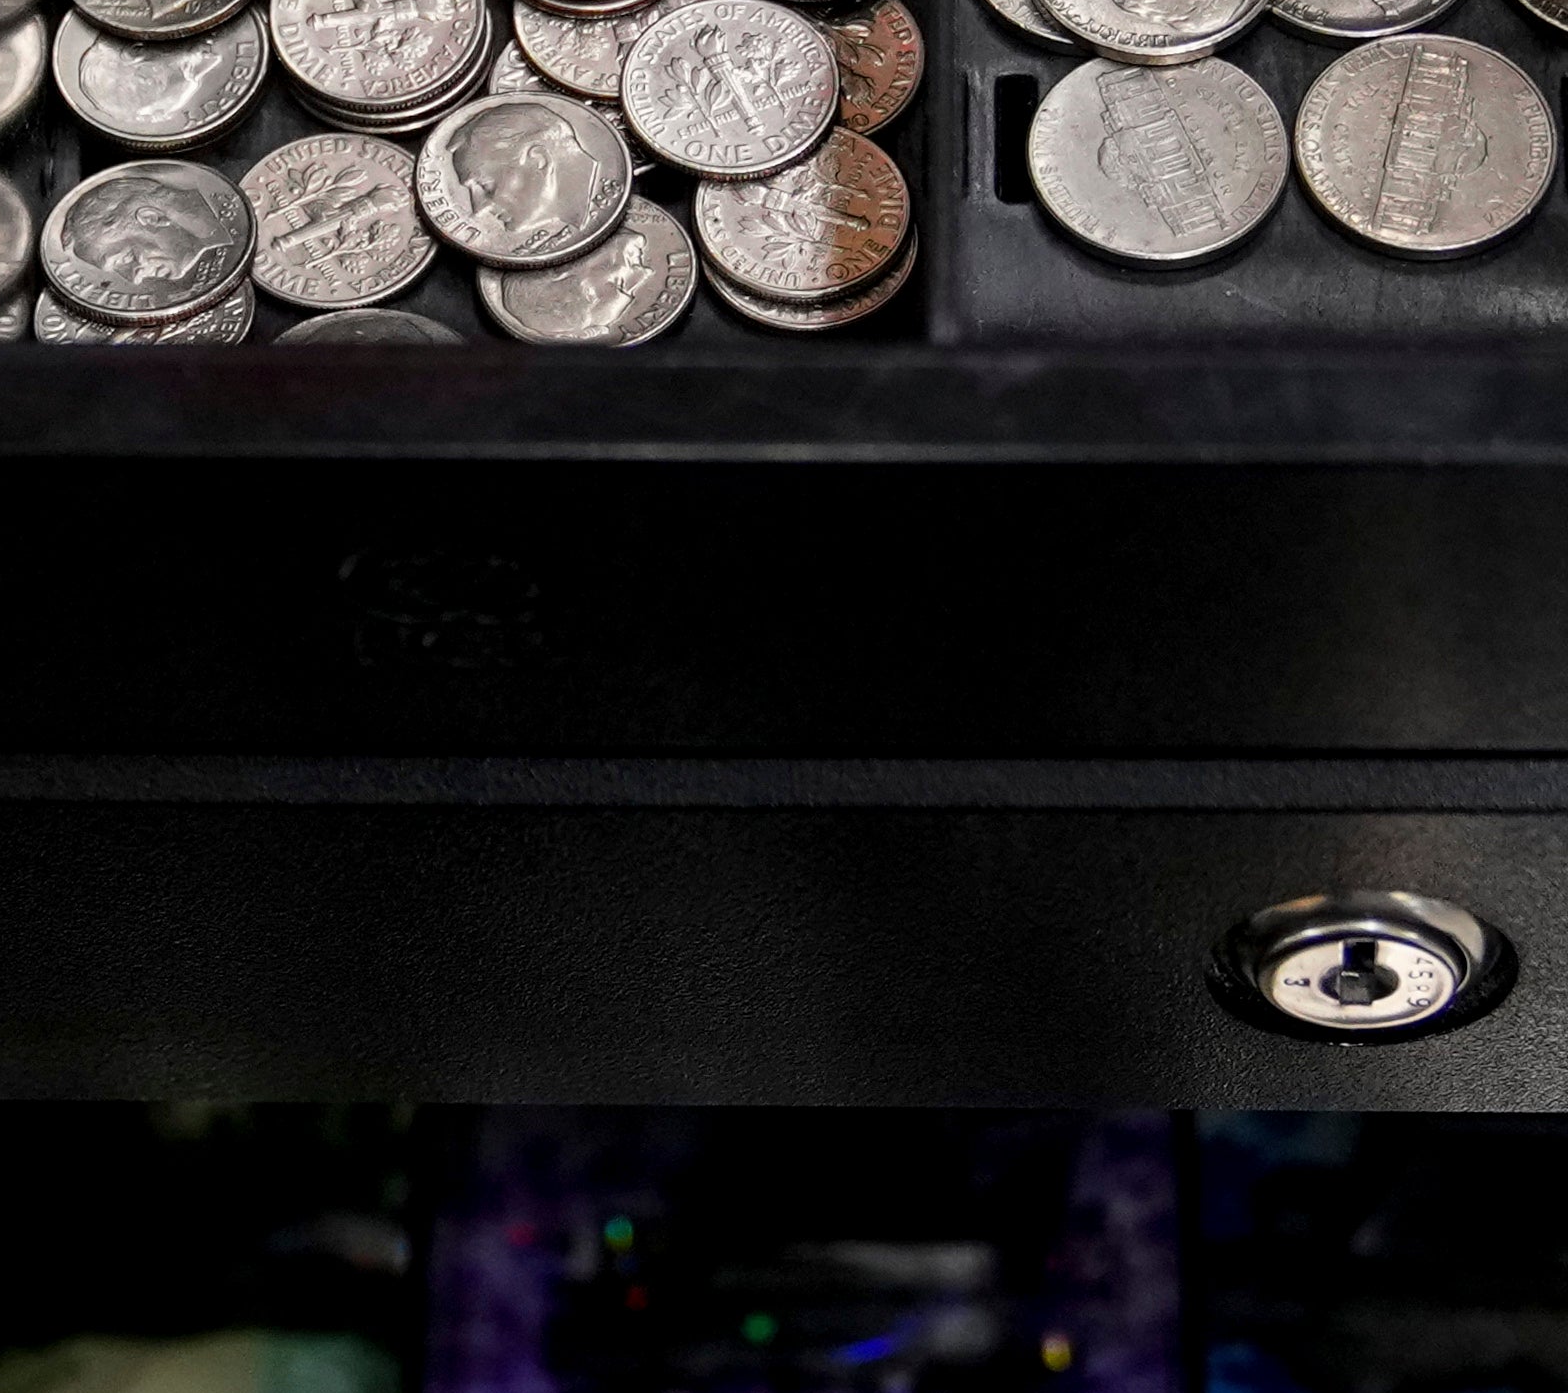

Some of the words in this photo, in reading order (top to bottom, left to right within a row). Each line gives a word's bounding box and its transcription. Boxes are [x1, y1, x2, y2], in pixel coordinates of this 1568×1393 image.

[278, 22, 339, 88] DIME
[452, 17, 476, 47] OF
[522, 23, 590, 82] AMERICA
[1086, 16, 1171, 49] LIBERTY
[181, 40, 256, 132] LIBERTY
[359, 43, 462, 97] AMERICA
[629, 69, 666, 139] UNITED
[648, 7, 706, 65] STATES
[715, 2, 747, 23] OF
[752, 7, 830, 79] AMERICA
[265, 136, 353, 173] UNITED
[682, 138, 754, 166] ONE
[763, 95, 828, 159] DIME
[418, 149, 481, 246] LIBERTY
[825, 237, 892, 282] ONE
[869, 162, 907, 232] DIME
[52, 258, 158, 310] LIBERTY
[254, 252, 322, 298] DIME
[719, 245, 803, 289] UNITED
[616, 250, 688, 344] LIBERTY
